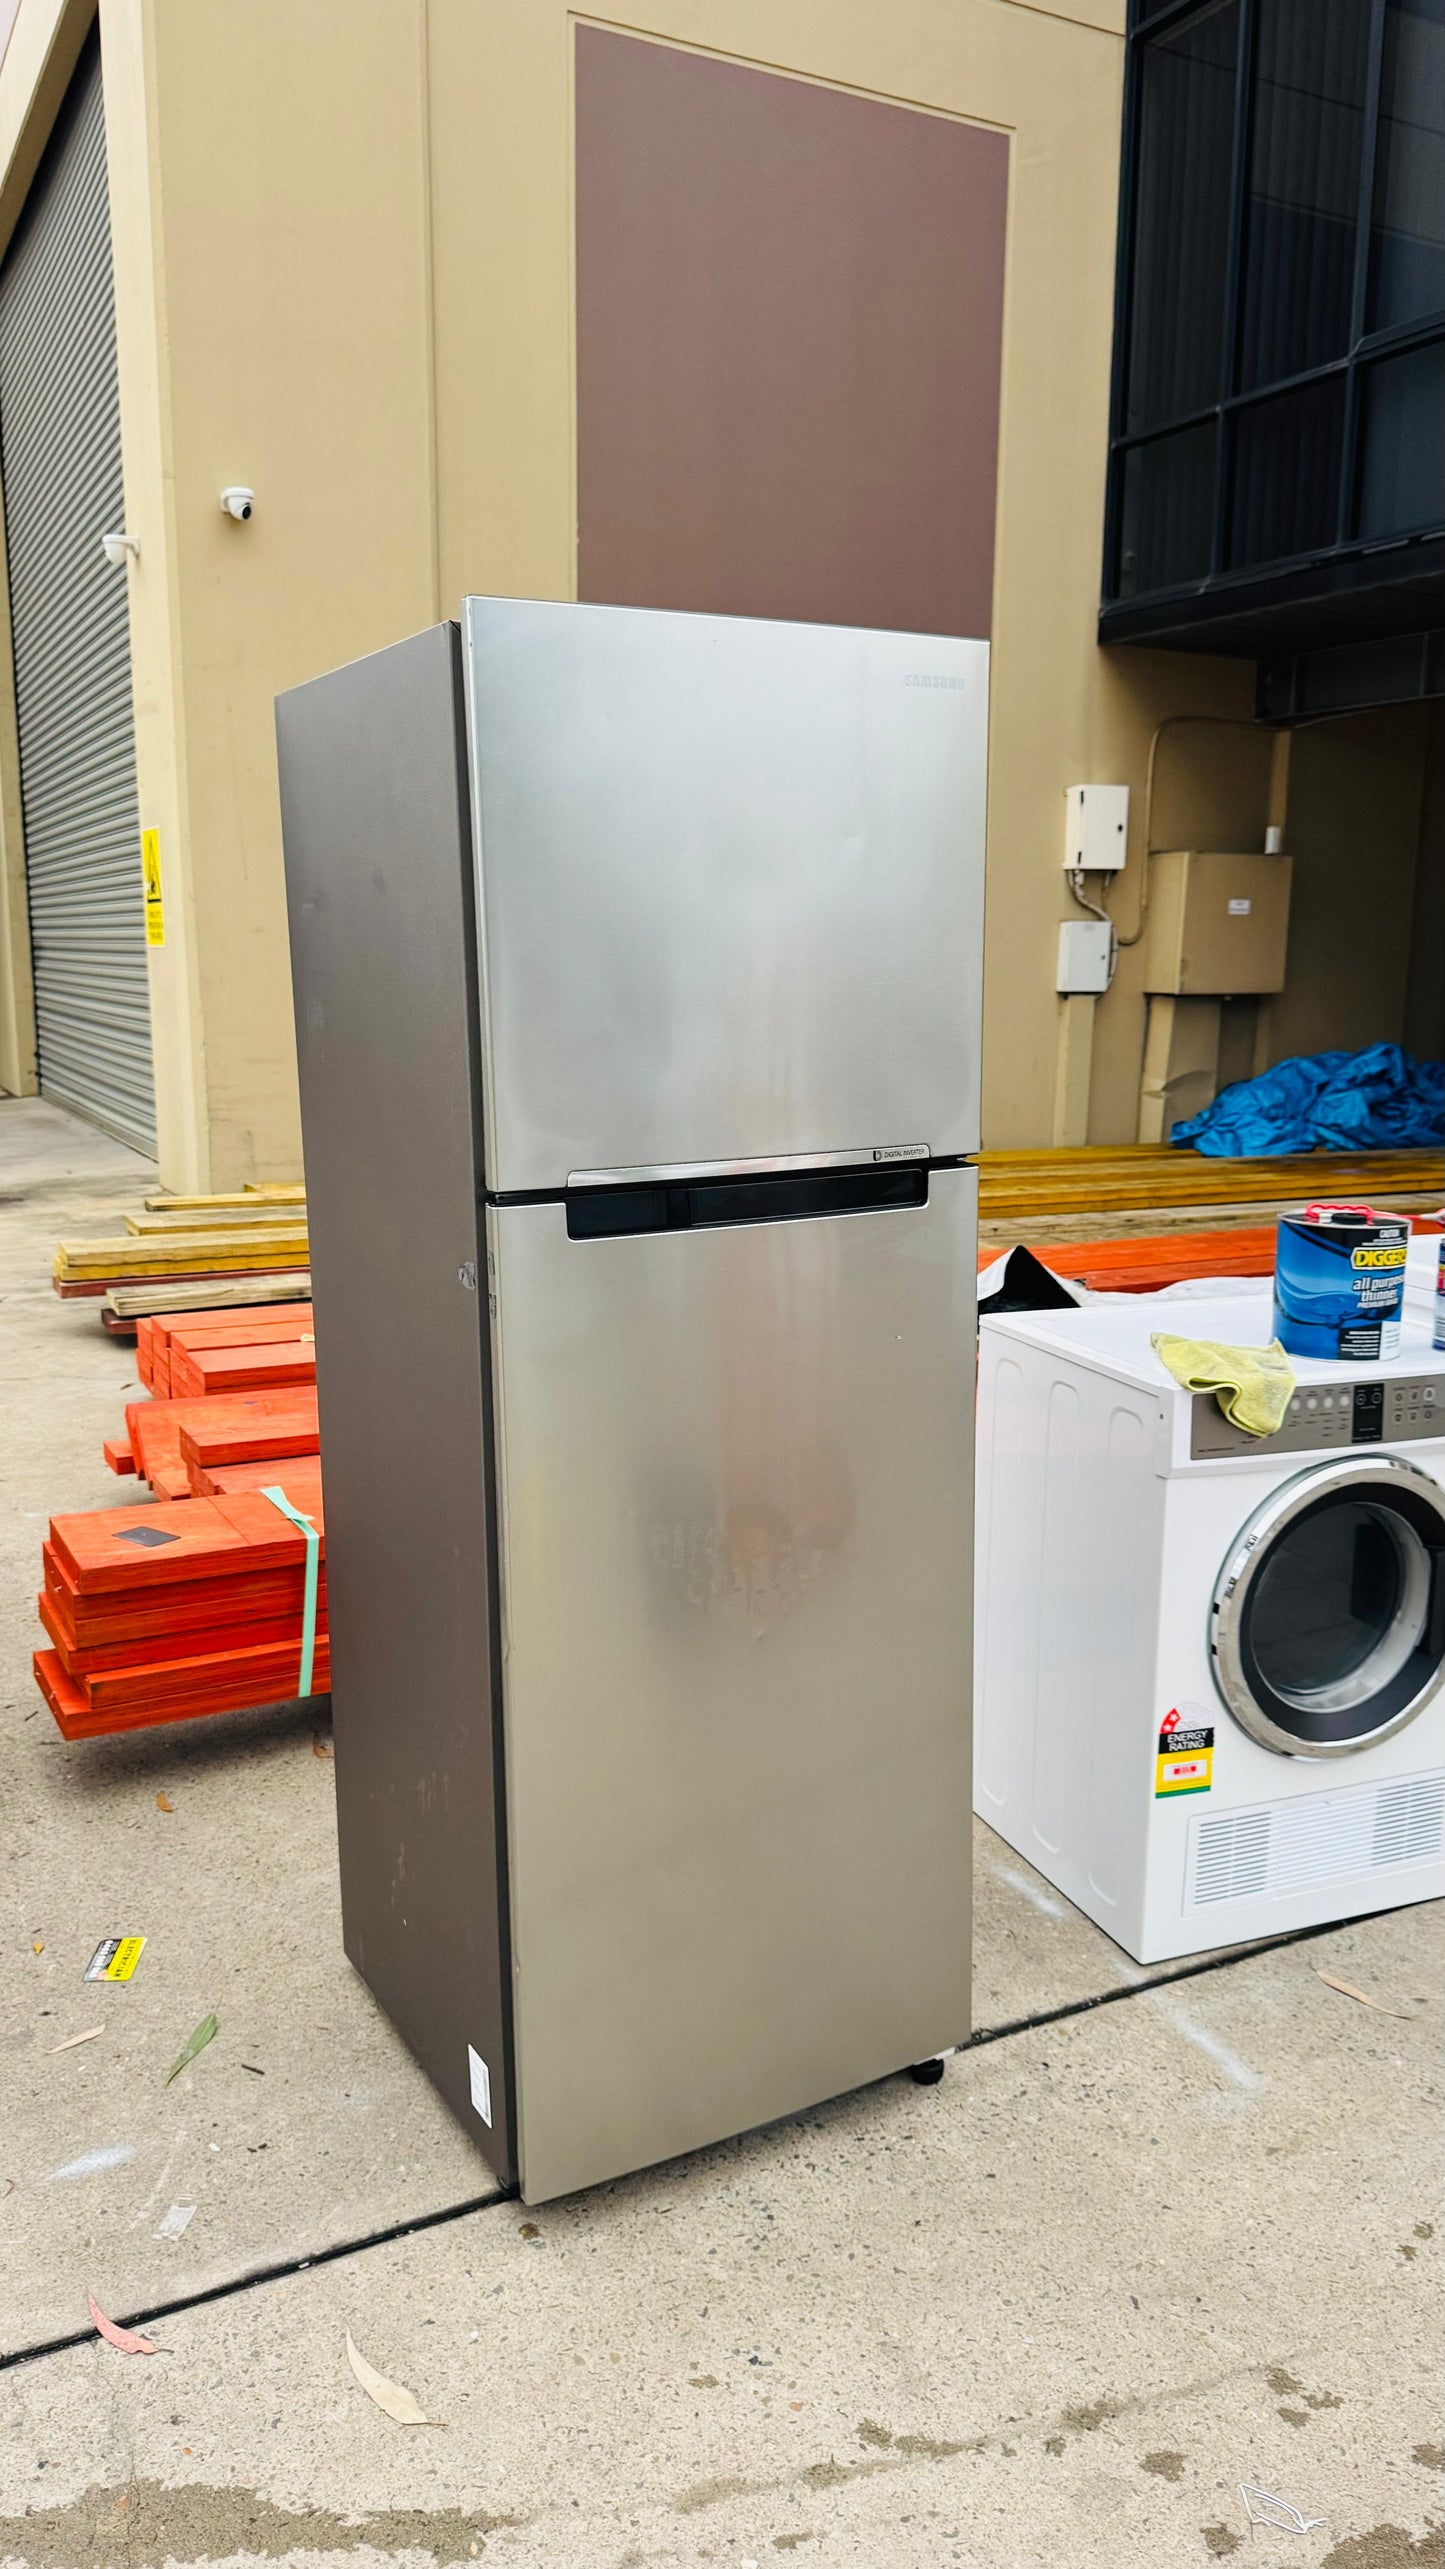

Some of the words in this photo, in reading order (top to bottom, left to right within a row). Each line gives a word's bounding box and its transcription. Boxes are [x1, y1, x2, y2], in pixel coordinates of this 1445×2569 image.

[904, 674, 965, 690] SAMSUNG
[1353, 1277, 1371, 1291] all
[1371, 1274, 1405, 1291] purpos
[1167, 1730, 1208, 1744] ENERGY
[1168, 1739, 1205, 1752] RATING
